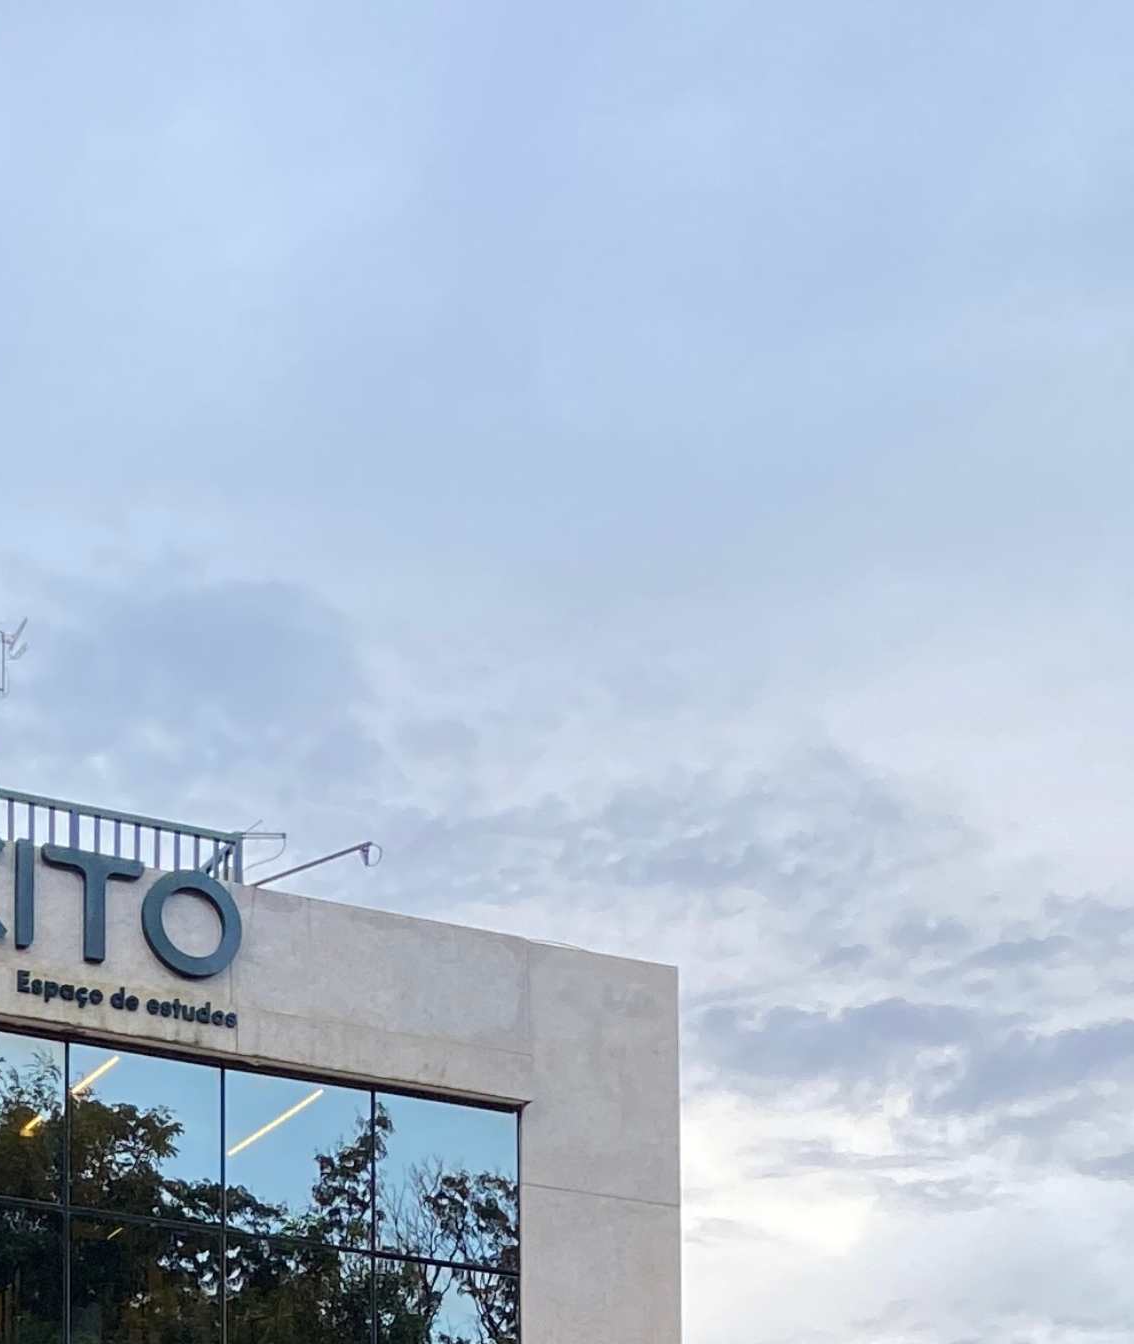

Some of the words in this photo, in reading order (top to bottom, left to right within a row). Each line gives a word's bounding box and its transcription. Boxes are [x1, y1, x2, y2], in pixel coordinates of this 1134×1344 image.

[17, 969, 104, 1008] Espaço
[110, 987, 139, 1011] de
[146, 998, 238, 1028] estudos
